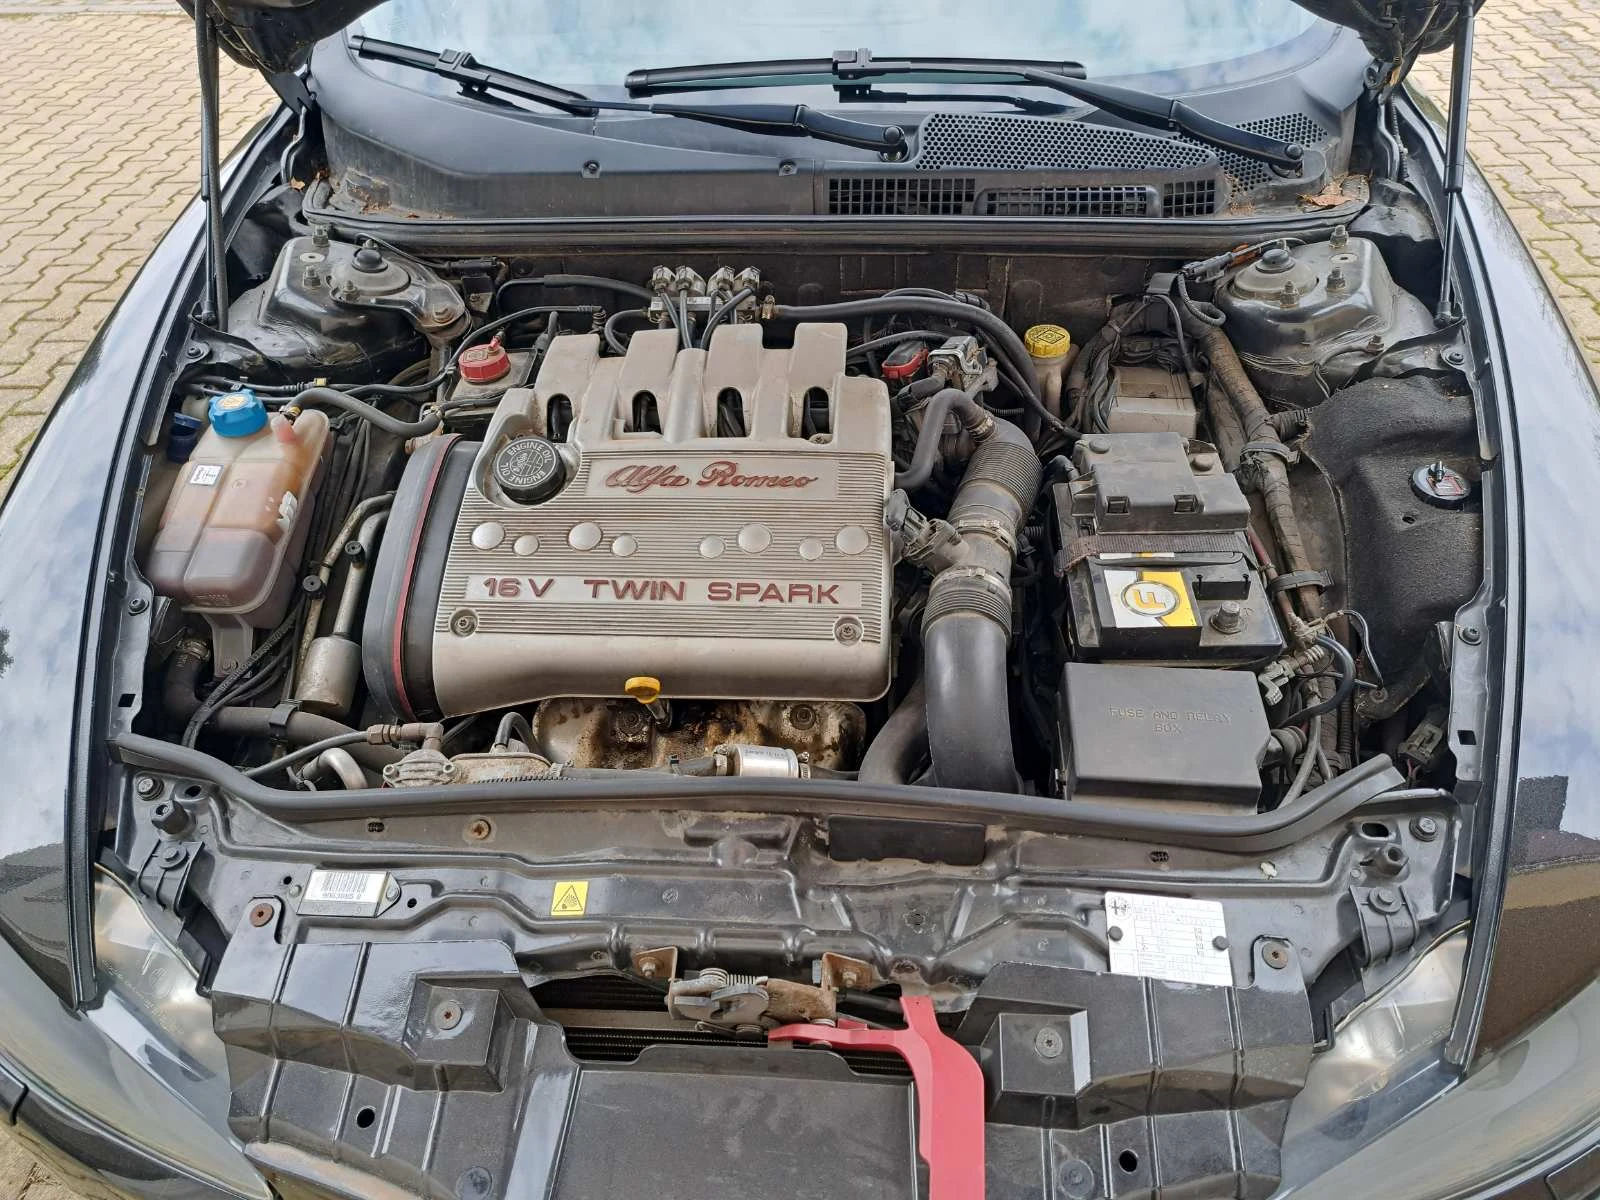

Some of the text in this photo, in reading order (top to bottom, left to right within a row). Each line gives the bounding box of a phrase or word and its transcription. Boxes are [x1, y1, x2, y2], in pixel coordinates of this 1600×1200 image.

[507, 442, 552, 463] ENGINE OIL
[501, 463, 546, 484] ENGINE OIL
[605, 461, 818, 493] Alfa Romeo
[584, 579, 685, 600] TWIN
[707, 581, 840, 604] SPARK
[1109, 704, 1232, 723] FUSE AND RELAY
[1154, 722, 1183, 734] BOX
